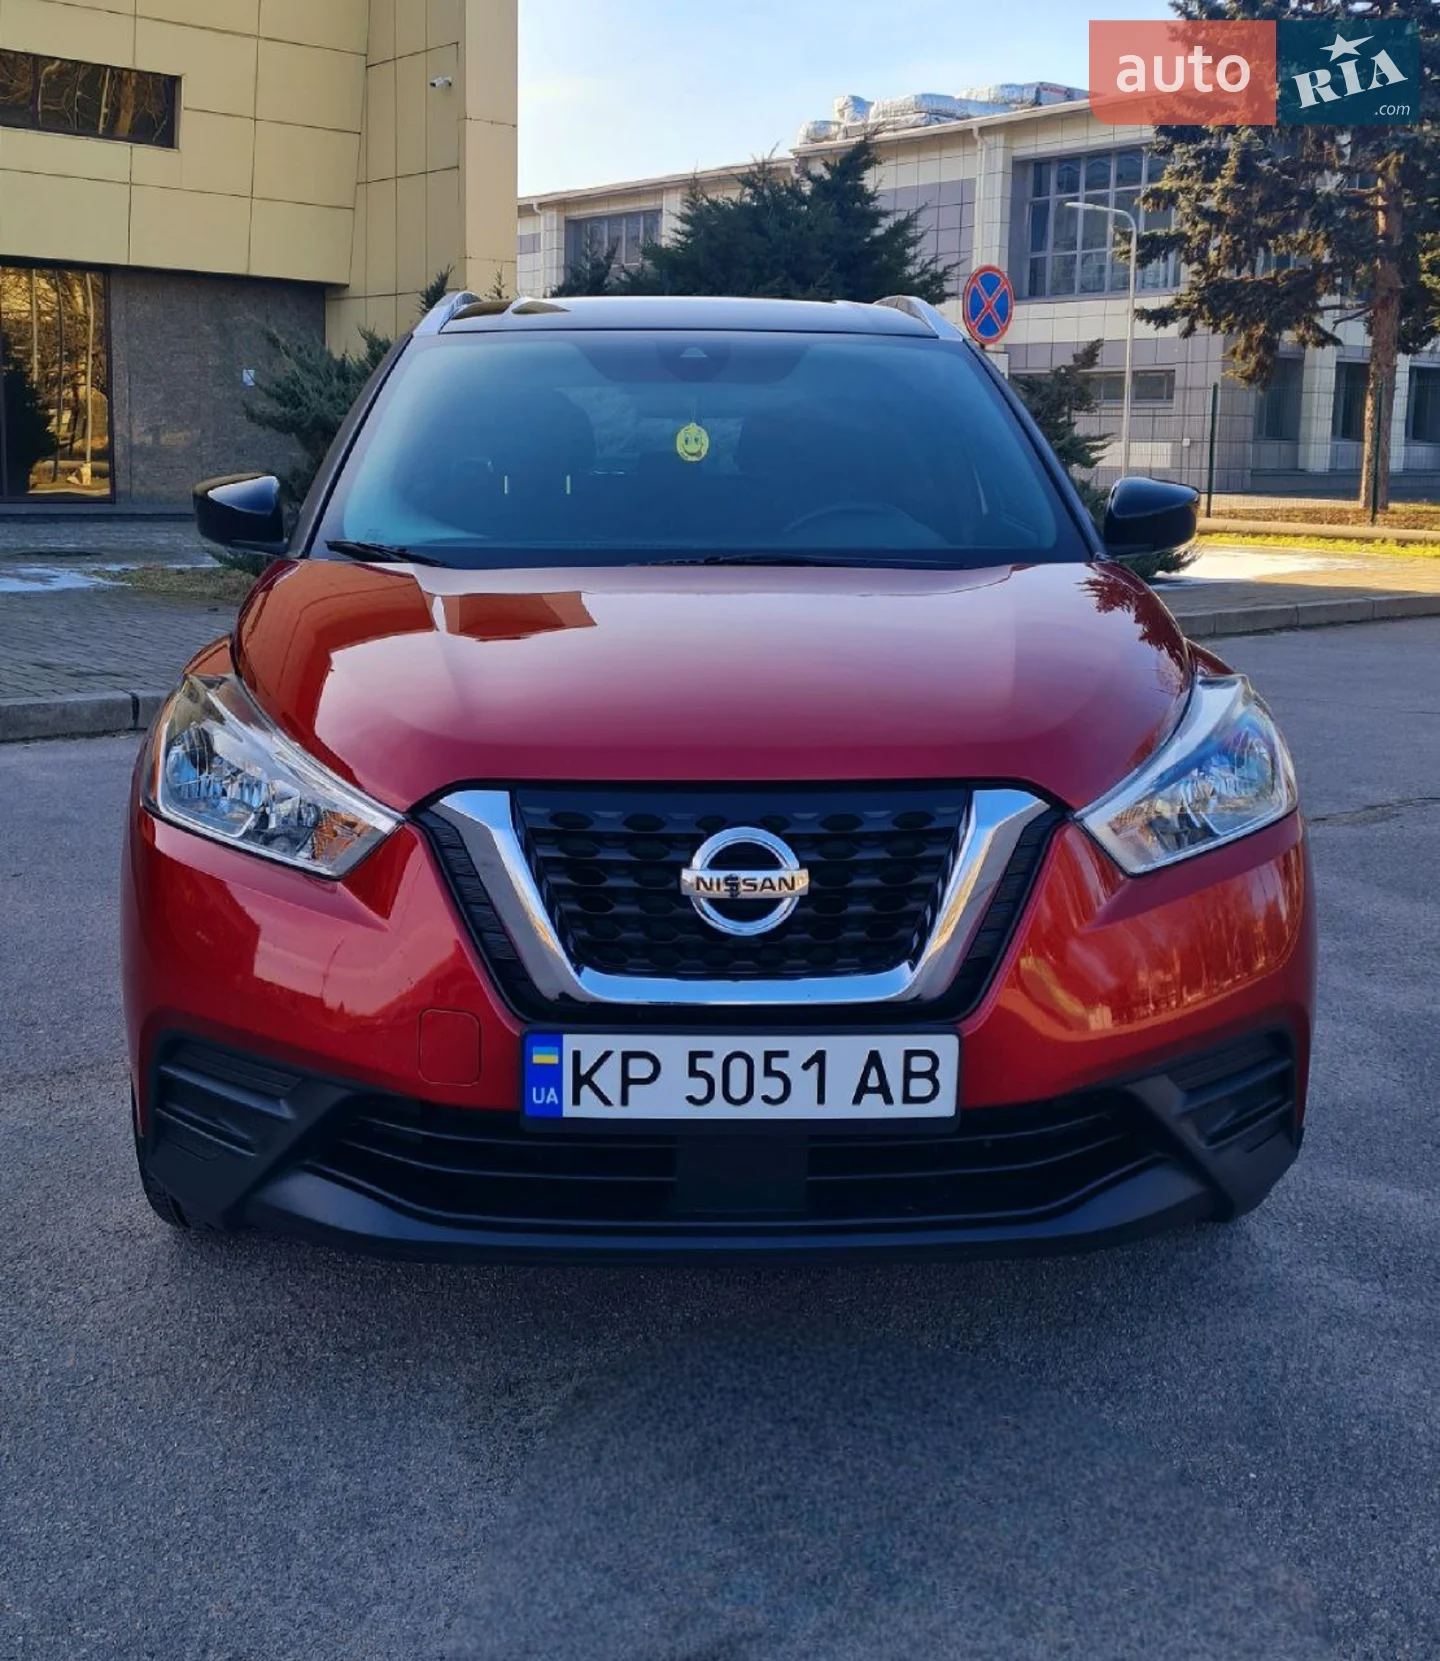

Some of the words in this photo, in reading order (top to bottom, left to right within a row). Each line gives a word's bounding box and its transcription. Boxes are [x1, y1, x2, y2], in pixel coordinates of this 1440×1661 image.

[695, 876, 795, 892] NISSAN
[571, 1049, 662, 1107] KP
[685, 1050, 827, 1106] 5051
[851, 1049, 941, 1106] AB
[532, 1087, 559, 1105] UA
